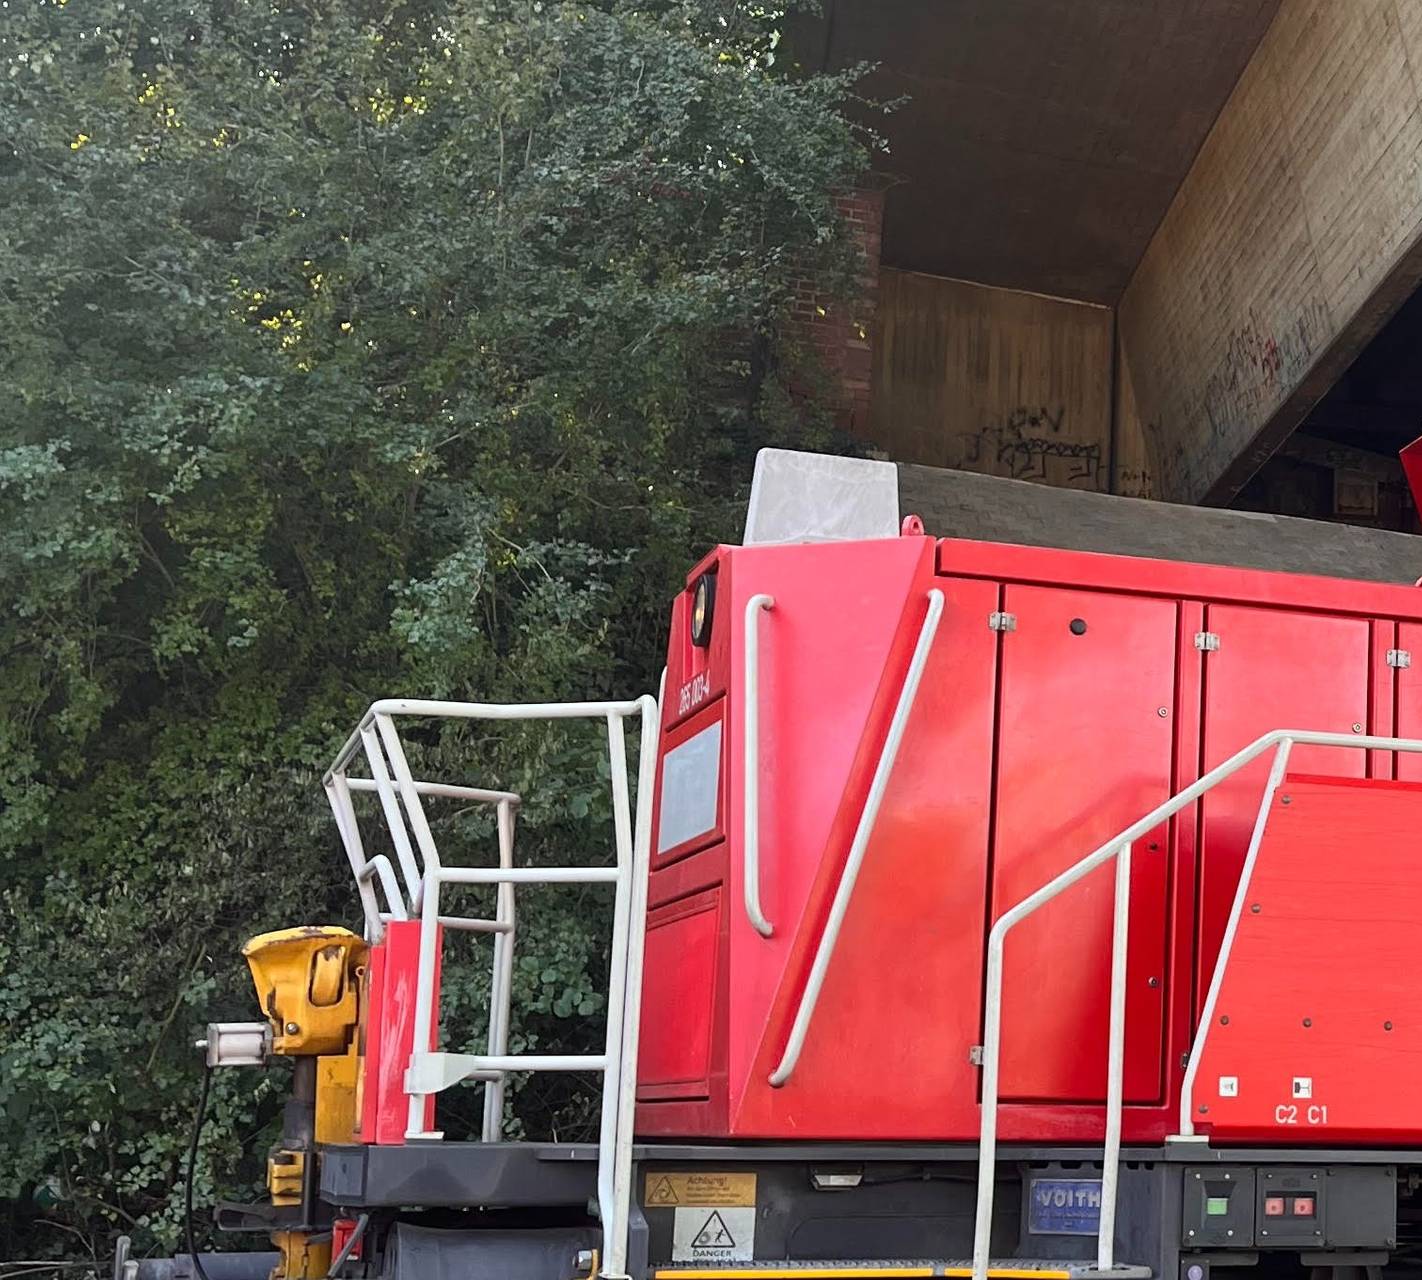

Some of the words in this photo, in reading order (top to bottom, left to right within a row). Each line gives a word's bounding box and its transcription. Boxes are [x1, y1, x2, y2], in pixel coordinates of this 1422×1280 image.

[1275, 1104, 1298, 1124] C2
[1307, 1105, 1327, 1124] C1
[687, 1176, 728, 1187] Achtung!
[1040, 1188, 1101, 1208] VOITH
[692, 1249, 732, 1257] DANGER
